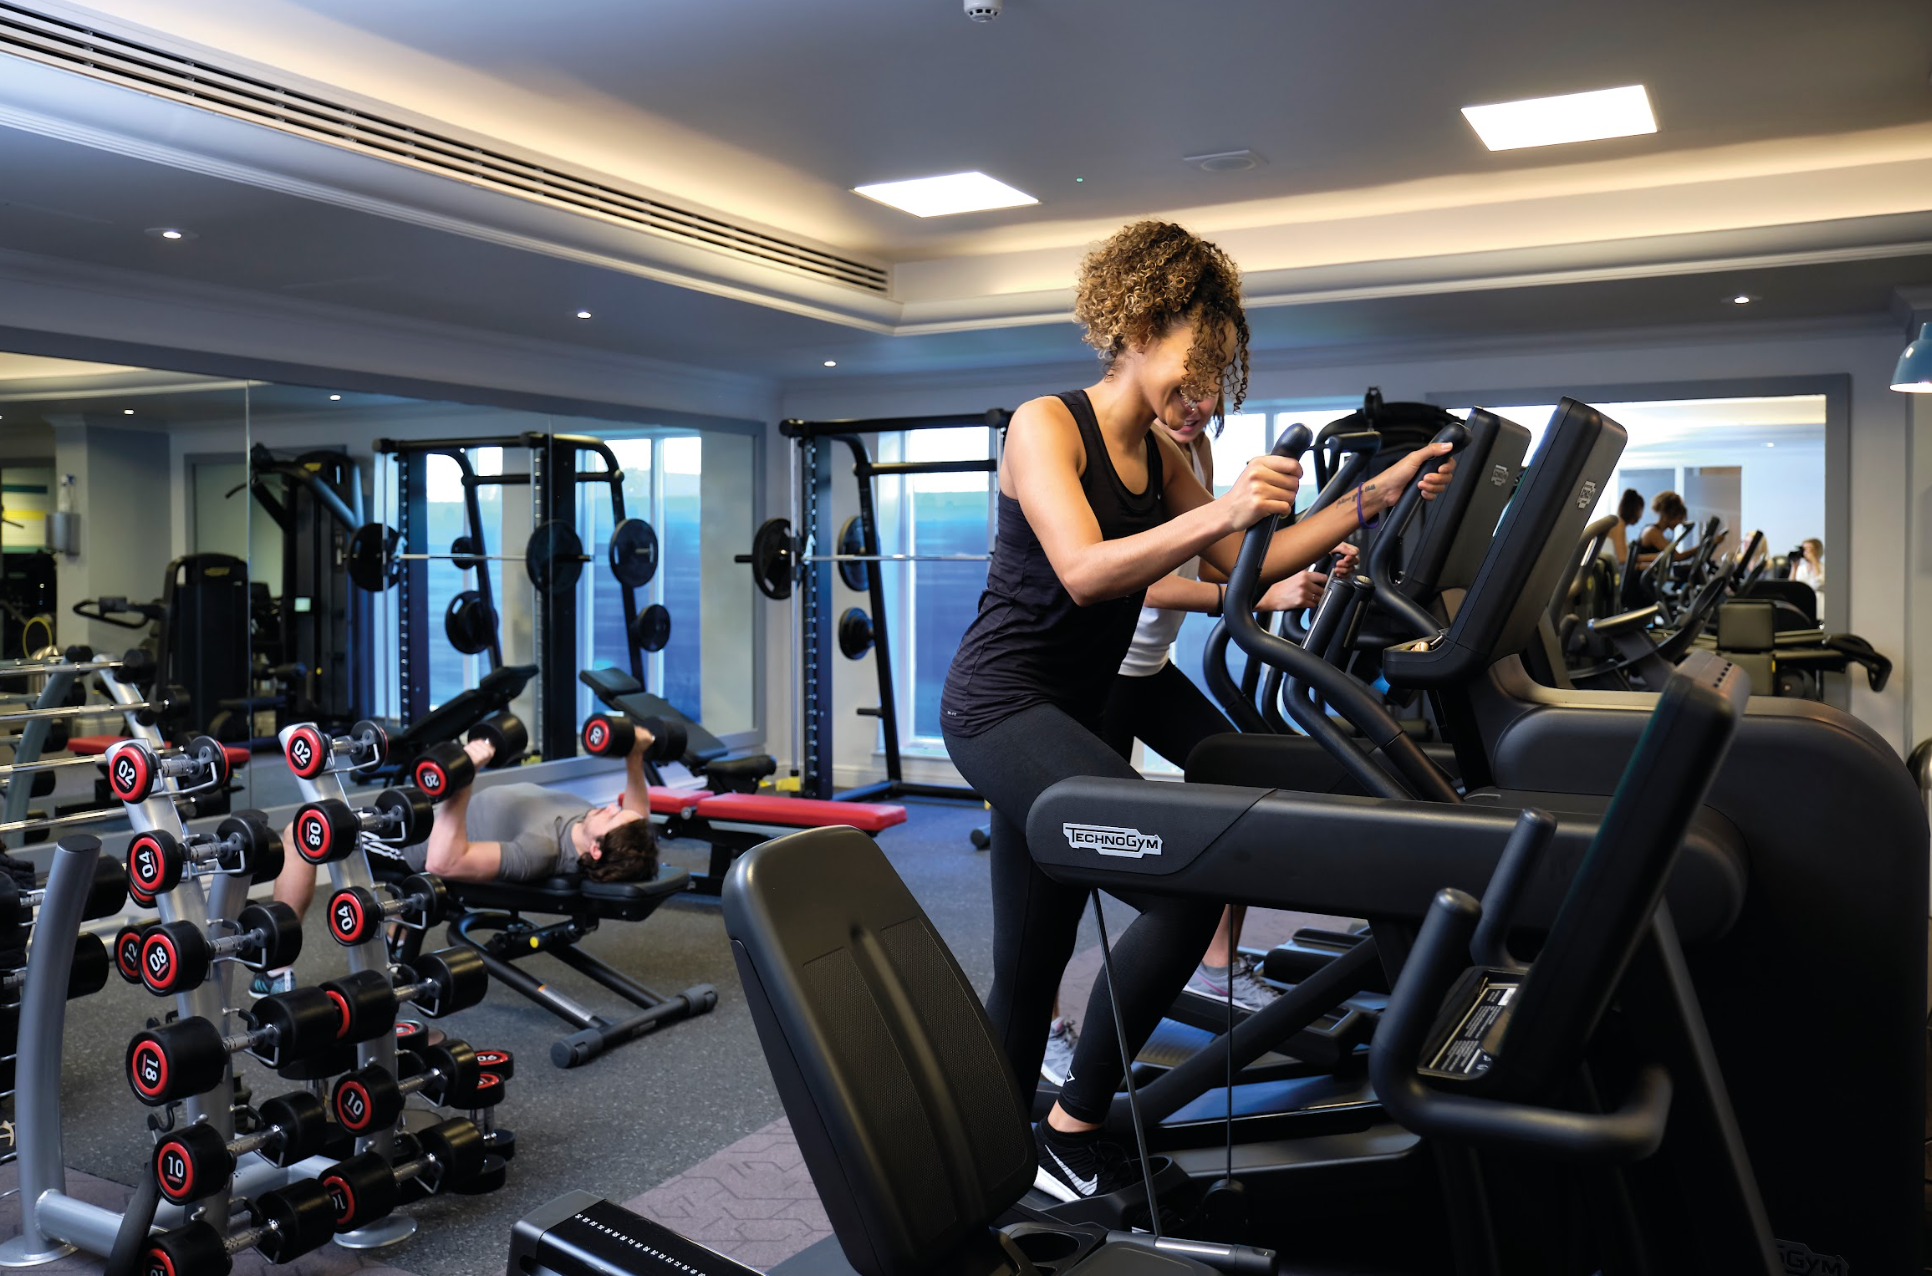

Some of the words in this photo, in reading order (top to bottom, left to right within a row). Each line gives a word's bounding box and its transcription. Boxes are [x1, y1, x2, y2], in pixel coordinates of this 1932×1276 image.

[294, 739, 311, 764] 02
[117, 760, 136, 786] 02
[424, 774, 440, 788] 20
[309, 821, 321, 846] 08
[1065, 827, 1159, 853] TECHNOGYM
[139, 850, 154, 878] 04
[338, 905, 353, 931] 04
[124, 942, 138, 963] 12
[149, 946, 167, 972] 08
[145, 1058, 159, 1082] 18
[348, 1091, 364, 1116] 10
[167, 1155, 184, 1179] 10
